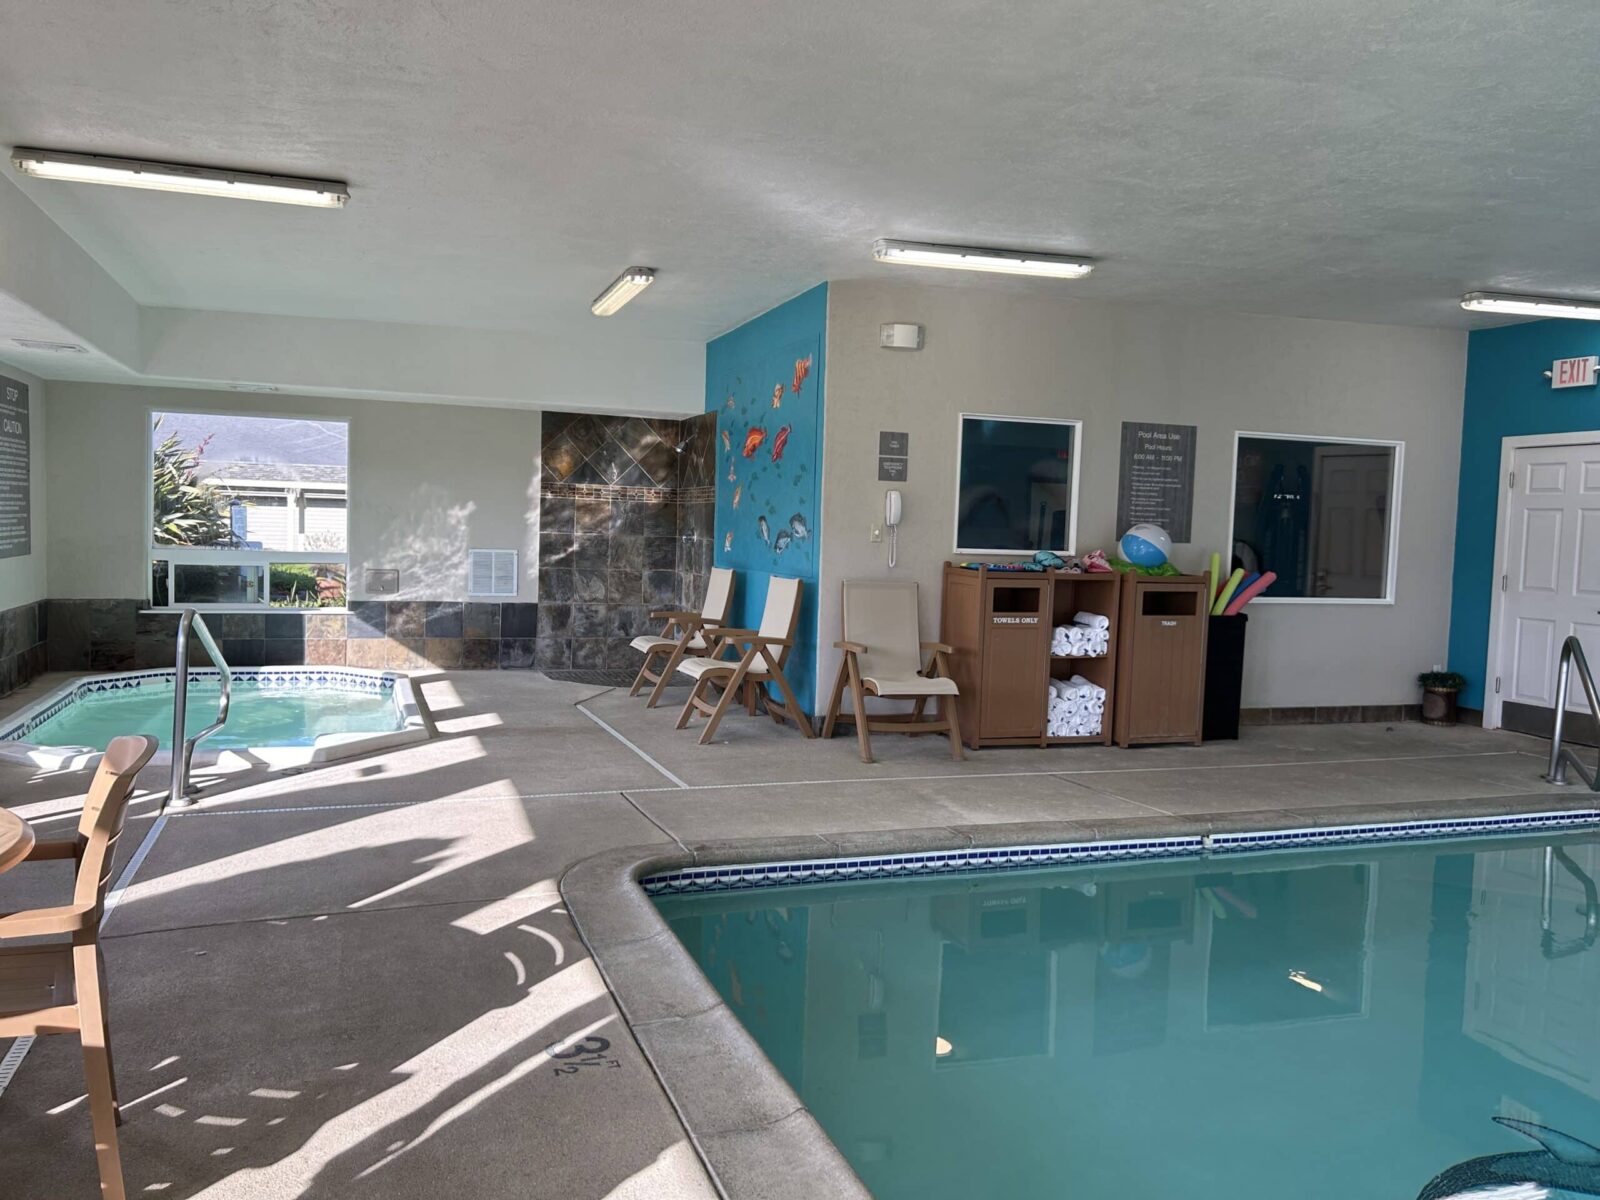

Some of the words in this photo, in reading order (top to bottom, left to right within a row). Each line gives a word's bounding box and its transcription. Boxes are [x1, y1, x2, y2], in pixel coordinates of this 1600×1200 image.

[1559, 358, 1589, 385] EXIT
[1138, 430, 1152, 439] Pool
[1153, 431, 1167, 440] Area
